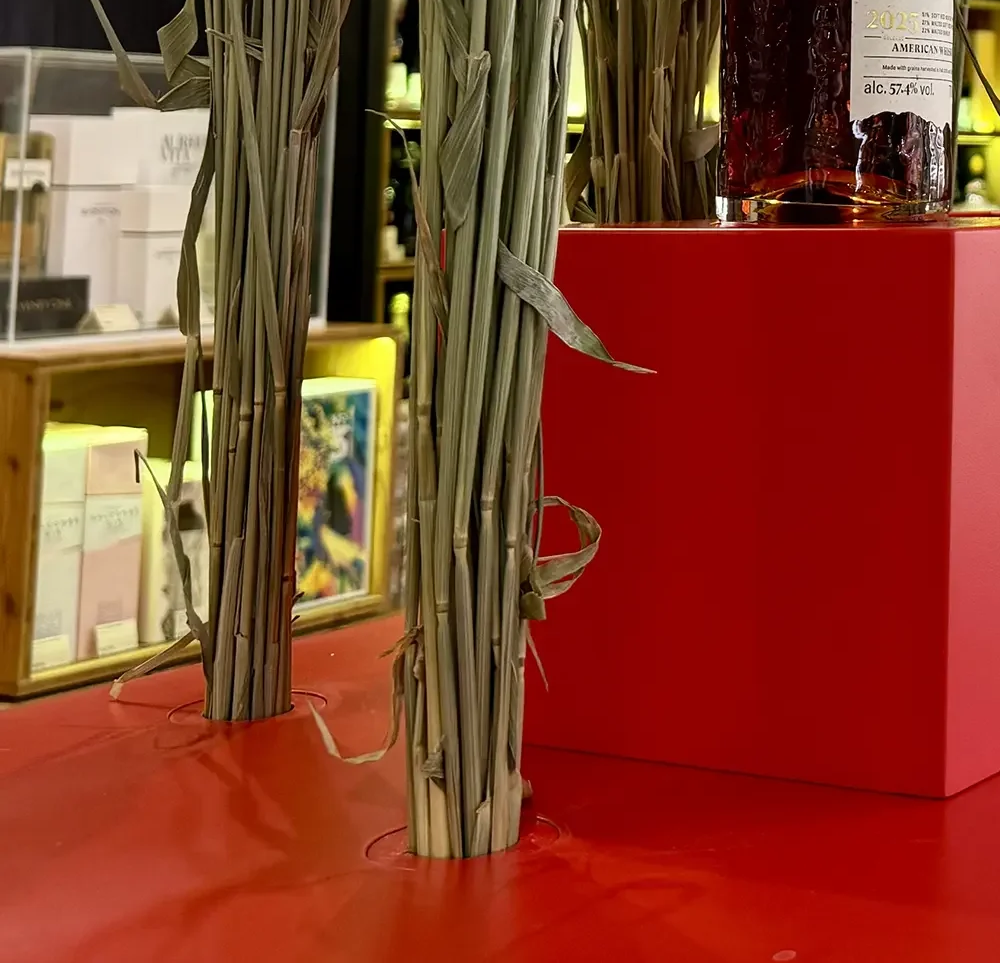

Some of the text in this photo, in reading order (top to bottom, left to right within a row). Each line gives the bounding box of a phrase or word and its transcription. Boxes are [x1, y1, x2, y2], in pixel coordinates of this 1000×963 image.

[866, 10, 920, 34] 2025
[892, 43, 938, 55] AMERICAN
[864, 80, 887, 95] alc.
[920, 83, 935, 96] vol.
